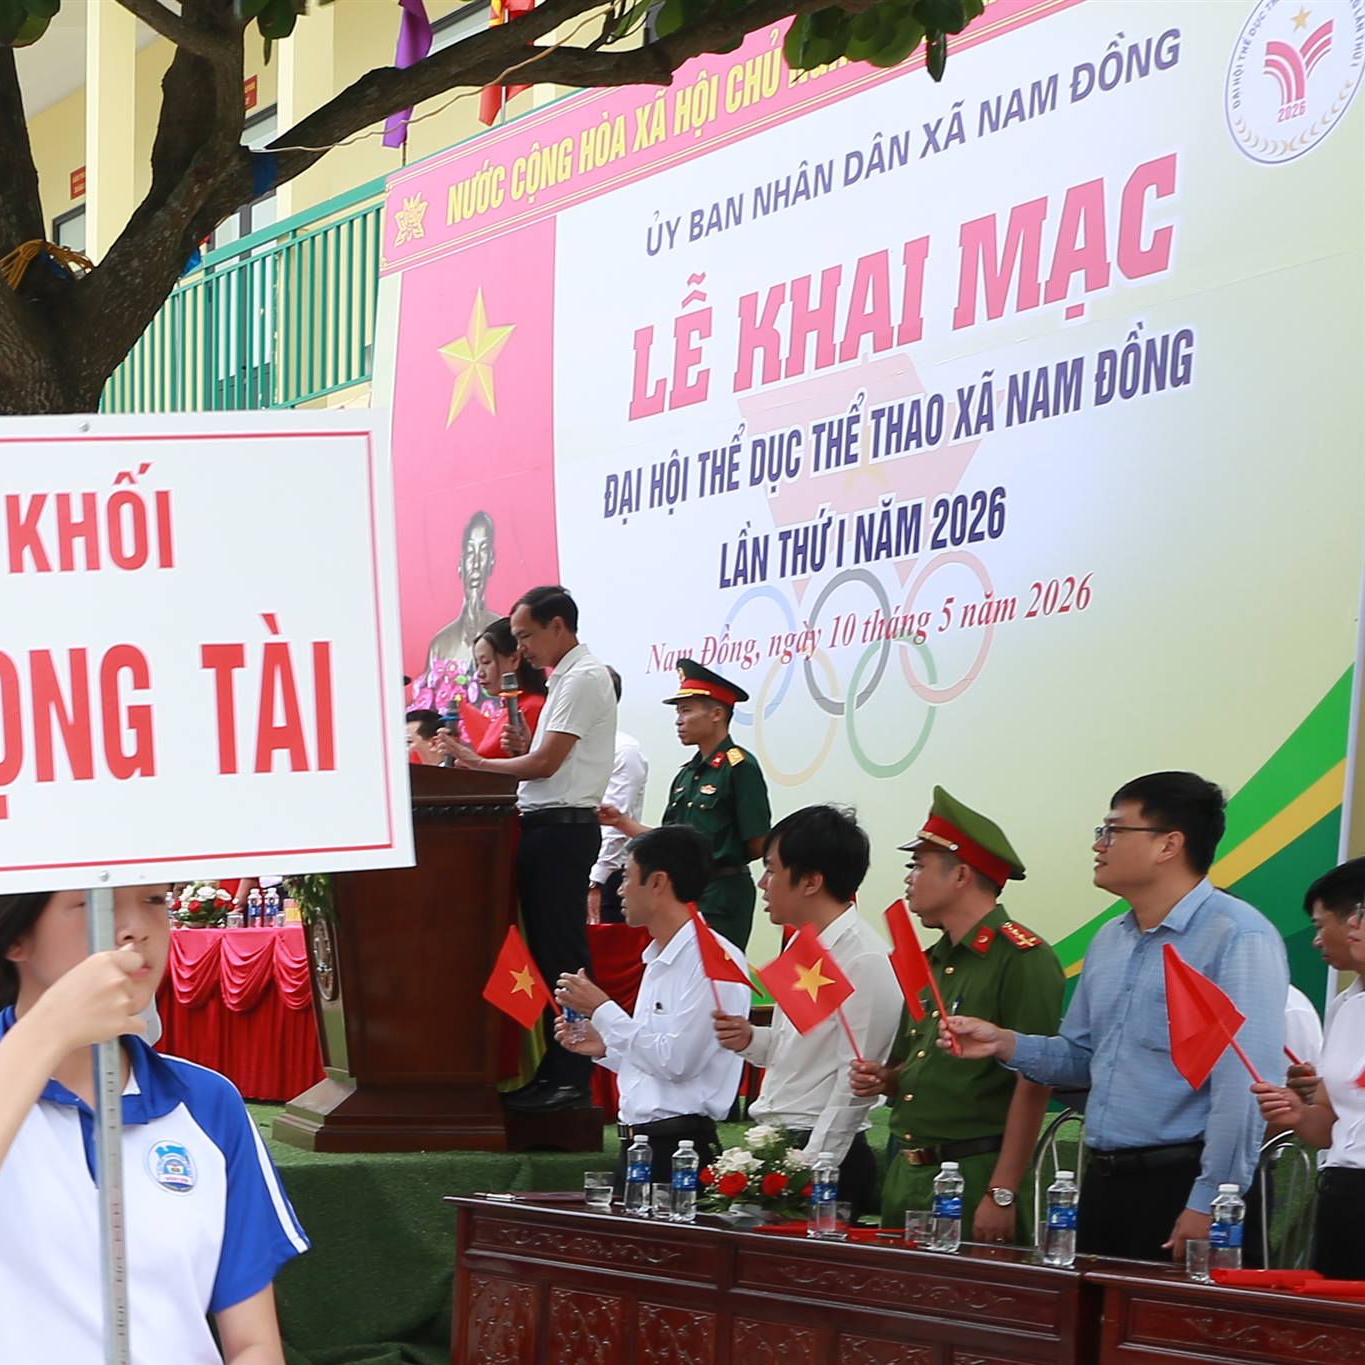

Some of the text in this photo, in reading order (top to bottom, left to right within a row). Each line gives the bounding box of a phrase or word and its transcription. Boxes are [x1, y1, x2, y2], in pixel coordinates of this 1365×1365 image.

[445, 156, 506, 227] NƯỚC
[511, 136, 574, 206] CỘNG
[578, 110, 626, 175] HÒA
[632, 90, 668, 153] XÃ
[673, 71, 719, 140] HỘI
[724, 28, 782, 112] CHỦ
[645, 28, 1182, 258] ỦY BAN NHÂN DÂN XÃ NAM ĐỒNG
[1276, 100, 1307, 123] 2026
[628, 152, 1178, 421] LỄ KHAI MẠC
[604, 321, 1195, 519] ĐẠI HỘI THỂ DỤC THỂ THAO XÃ NAM ĐỒNG
[3, 462, 175, 575] KHỐI
[719, 485, 1007, 588] LẦN THỨ I NĂM 2026
[200, 612, 337, 777] TÀI
[645, 570, 1096, 674] Nam Đồng, ngày 10 tháng 5 năm 2026
